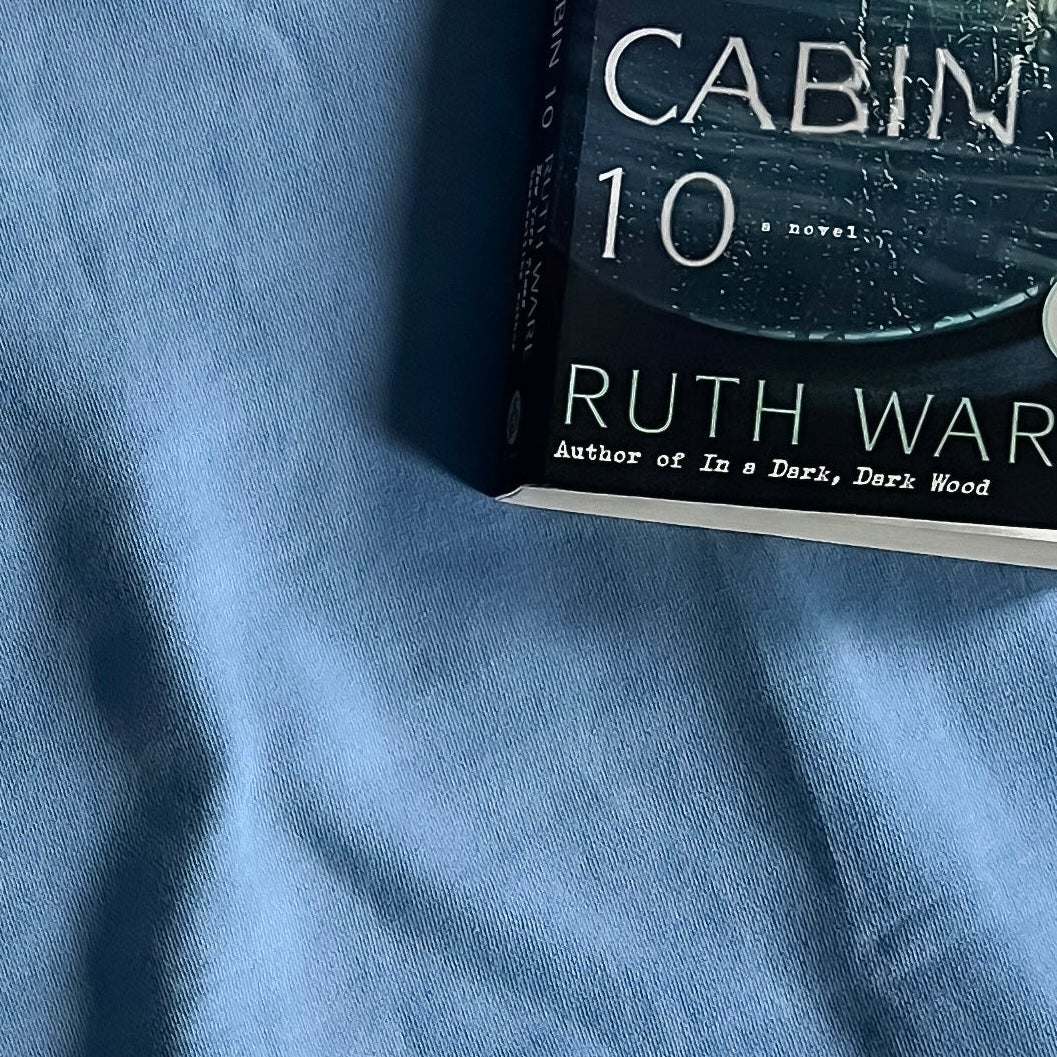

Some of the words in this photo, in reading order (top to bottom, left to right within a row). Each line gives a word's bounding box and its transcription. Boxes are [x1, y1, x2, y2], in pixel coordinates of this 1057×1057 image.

[541, 85, 557, 129] 10
[603, 27, 1026, 145] CABIN
[598, 167, 736, 267] 10
[761, 222, 771, 232] a
[788, 223, 858, 239] novel
[563, 363, 805, 445] RUTH
[854, 387, 1054, 468] WAR
[553, 440, 642, 464] Author
[656, 452, 686, 469] of
[699, 453, 730, 473] In
[743, 461, 756, 475] a
[768, 458, 841, 486] Dark,
[852, 466, 917, 490] Dark
[930, 472, 991, 496] Wood
